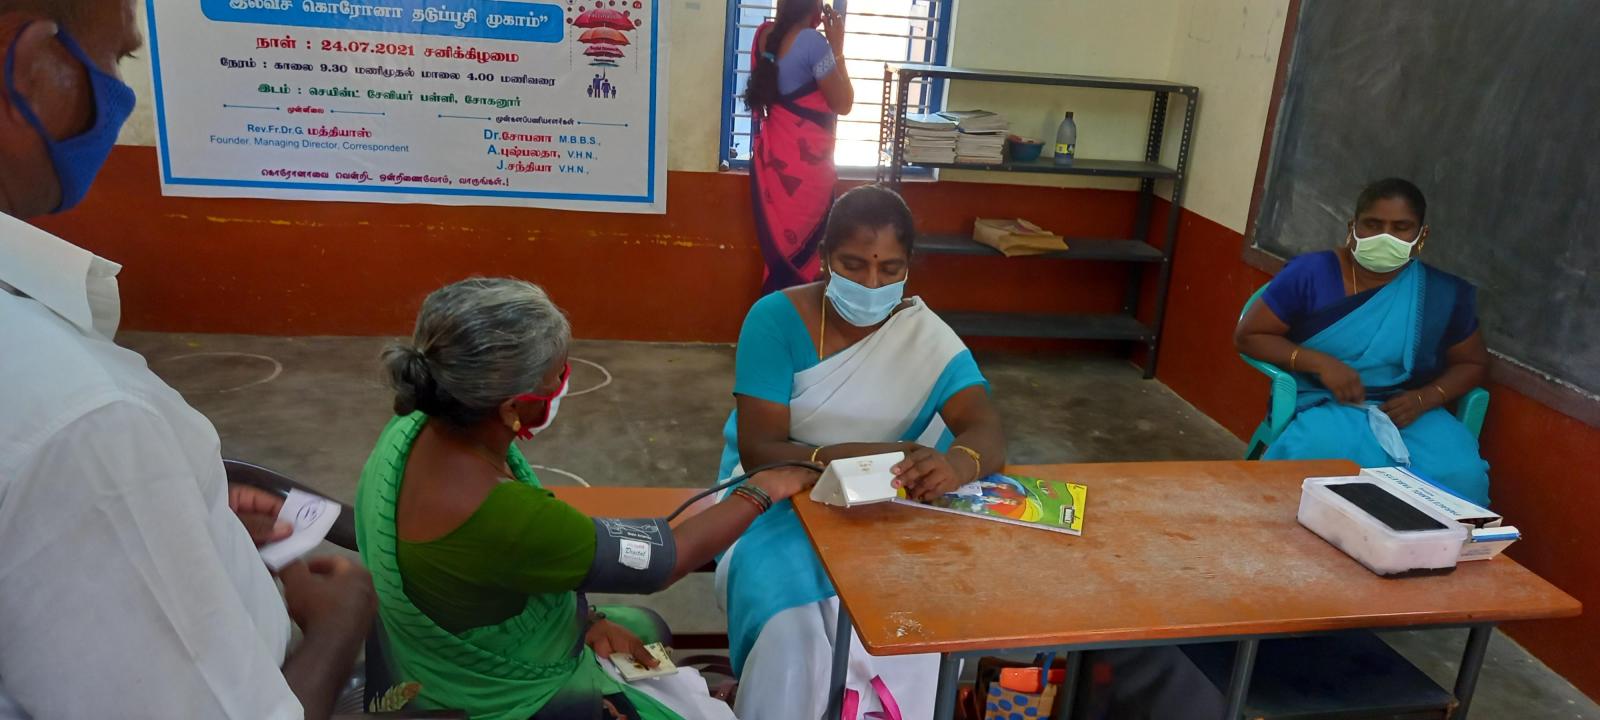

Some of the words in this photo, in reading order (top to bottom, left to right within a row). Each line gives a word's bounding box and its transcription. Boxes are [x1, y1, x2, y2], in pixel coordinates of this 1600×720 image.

[302, 0, 403, 19] கொரோனா
[411, 6, 477, 29] தடுப்பூசி
[486, 11, 549, 28] முகாம்”
[256, 35, 297, 50] நாள்
[321, 39, 416, 57] 24.07.2021
[423, 46, 520, 64] சனிக்கிழமை
[219, 56, 257, 70] நேரம்
[273, 61, 314, 72] காலை
[320, 63, 348, 74] 9.30
[355, 64, 416, 79] மணிமுதல்
[421, 70, 461, 82] மாலை
[466, 72, 495, 83] 4.00
[500, 74, 556, 87] மணிவரை
[257, 82, 291, 95] இடம்
[308, 86, 361, 99] செயின்ட்
[367, 87, 414, 102] சேவியர்
[464, 94, 522, 109] சோகனூர்
[254, 136, 300, 149] Managing
[342, 141, 410, 153] Correspondent
[307, 124, 373, 138] மத்தியாஸ்
[261, 167, 329, 180] கொரோனாவை
[335, 170, 373, 184] வென்றிட
